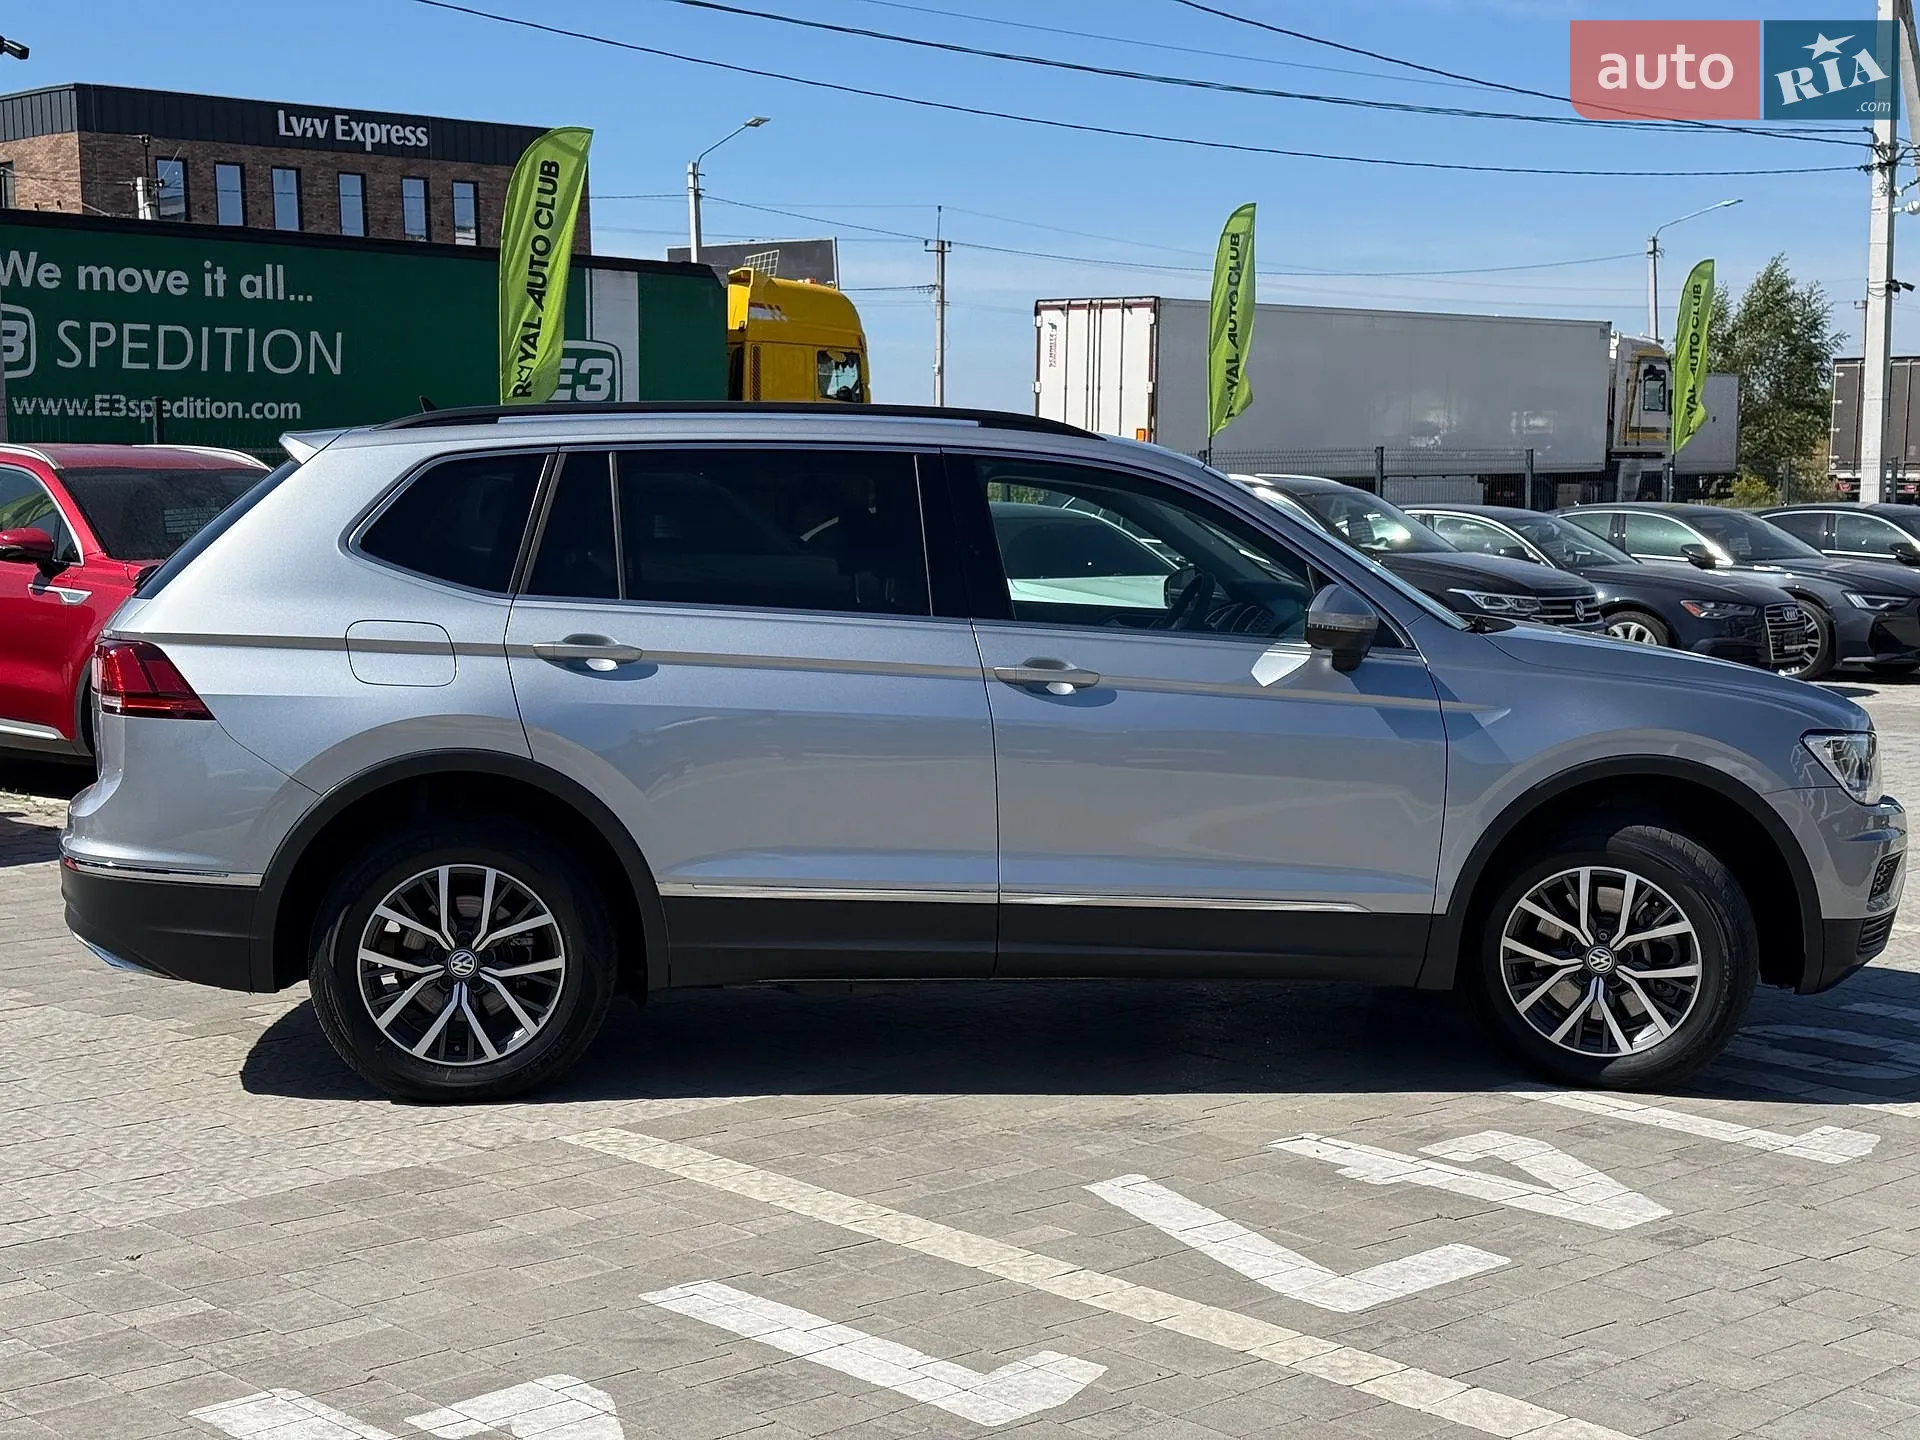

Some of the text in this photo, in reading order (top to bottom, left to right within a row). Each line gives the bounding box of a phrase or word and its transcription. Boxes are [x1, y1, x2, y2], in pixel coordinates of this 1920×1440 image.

[334, 114, 429, 152] Express
[533, 159, 560, 230] CLUB
[0, 250, 313, 302] We move it all...
[525, 234, 552, 311] AUTO
[1226, 232, 1241, 287] CLUB
[1227, 289, 1240, 350] AUTO
[1690, 283, 1703, 330] CLUB
[56, 319, 342, 375] SPEDITION
[549, 357, 613, 401] E3
[12, 394, 301, 423] www.E3spedition.com
